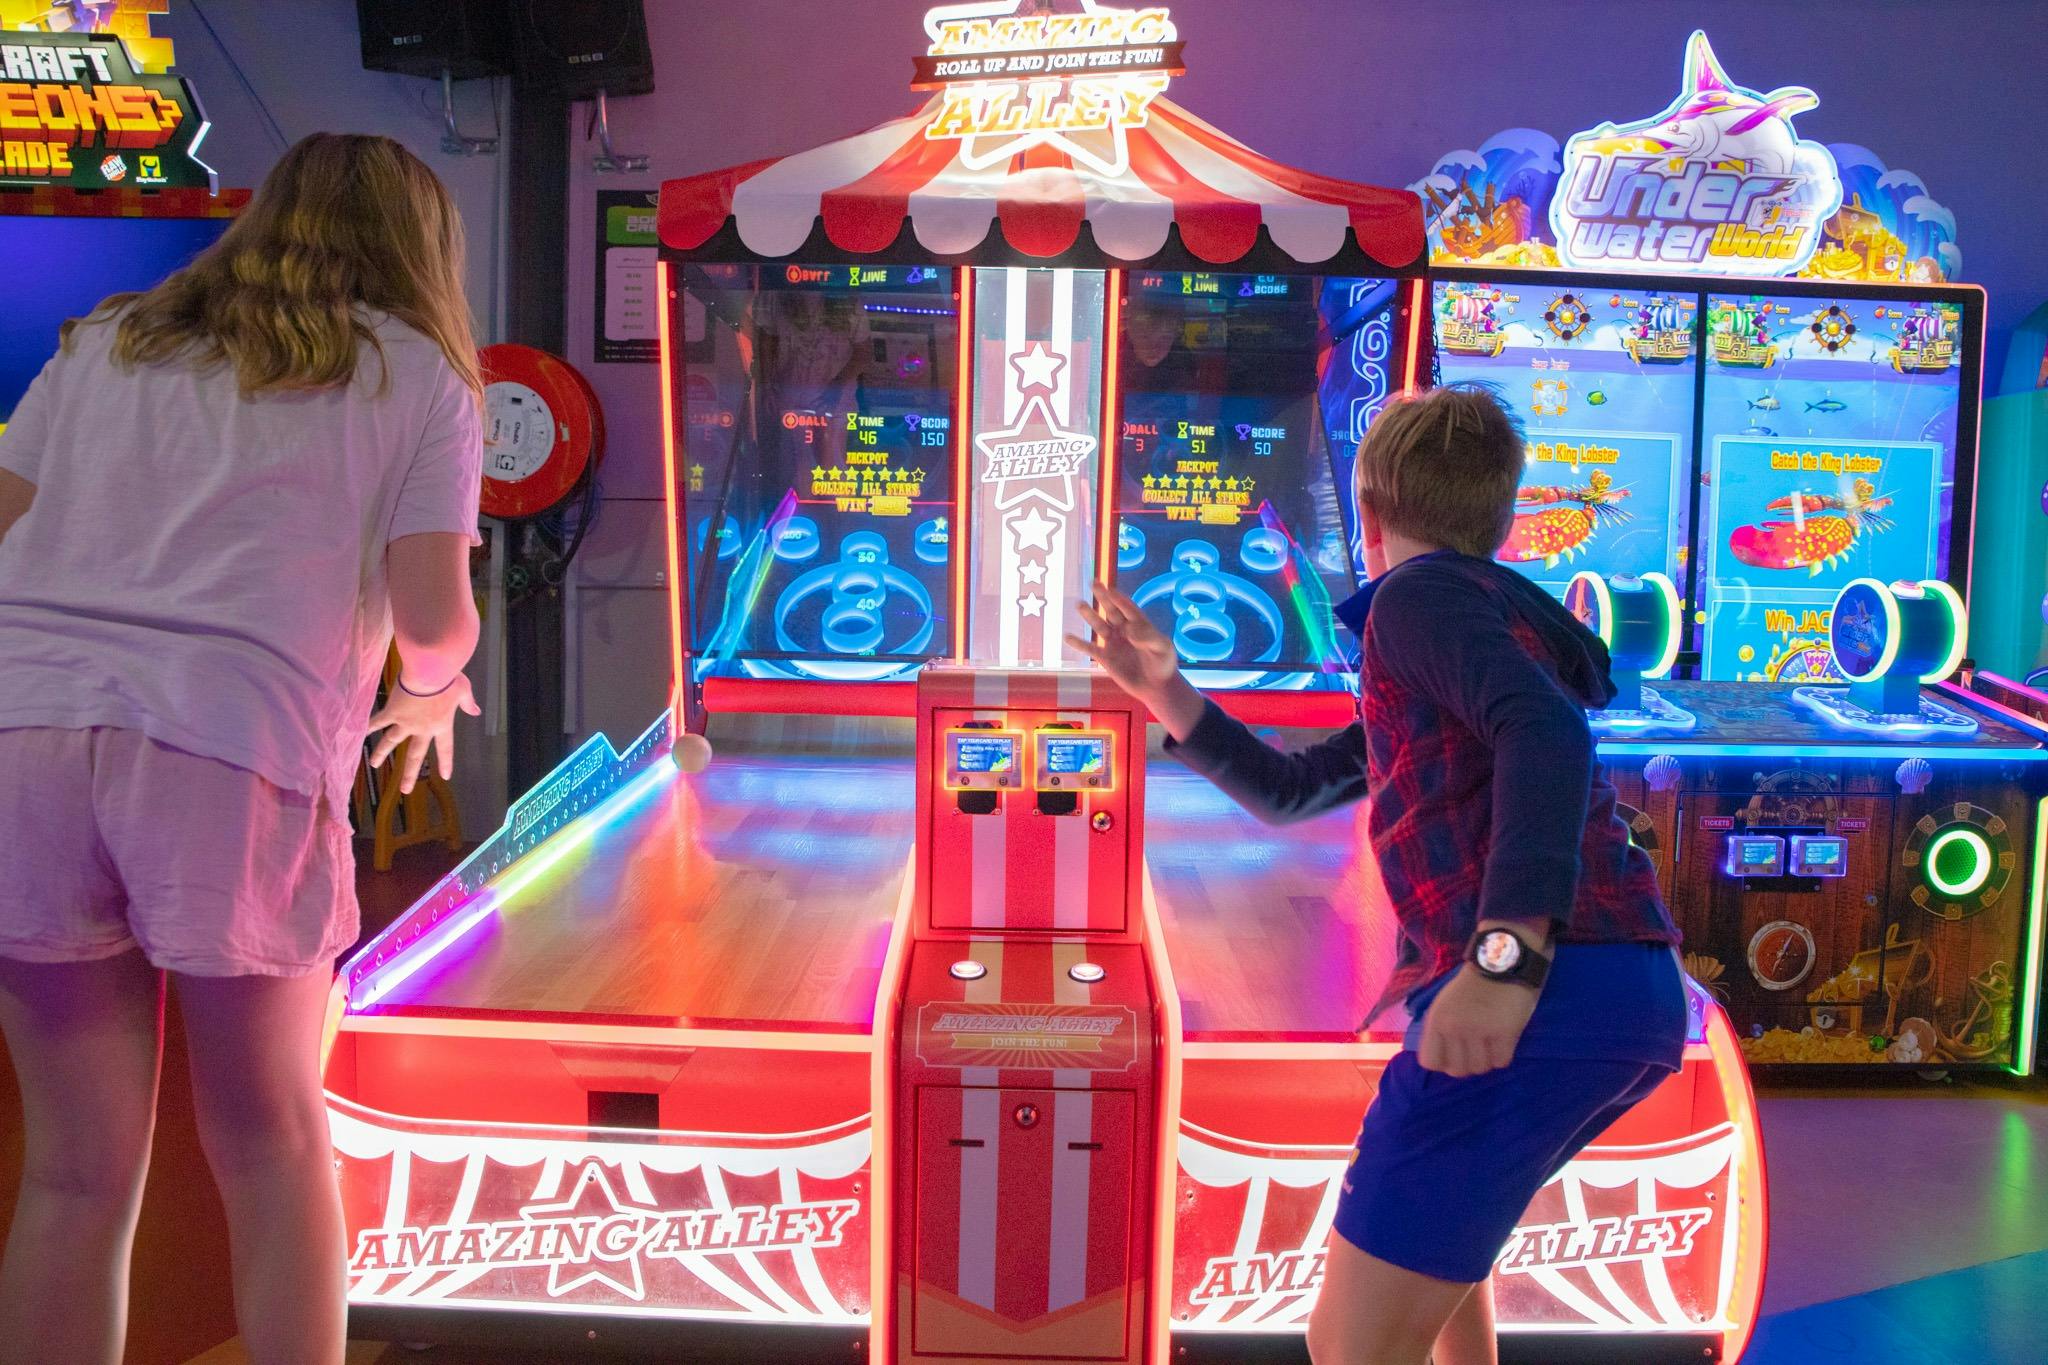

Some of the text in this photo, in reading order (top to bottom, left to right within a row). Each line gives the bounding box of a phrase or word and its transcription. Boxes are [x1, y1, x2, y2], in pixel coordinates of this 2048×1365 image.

[930, 13, 1166, 54] AMAZING
[0, 45, 113, 82] RAFT
[935, 48, 1164, 76] ROLL UP AND JOIN THE FUN!
[0, 83, 163, 142] EONS
[929, 79, 1166, 136] ALLEY
[0, 142, 74, 172] ADE
[1567, 156, 1798, 223] Under
[1710, 222, 1806, 259] World
[798, 416, 949, 429] BALL TIME SCOR
[1130, 424, 1286, 439] BALL TIME SCORE
[805, 430, 945, 446] 3 46 150
[1136, 438, 1272, 456] 3 51 50
[846, 452, 888, 465] JACKPOT
[993, 440, 1083, 459] AMAZING
[1536, 442, 1554, 461] the
[1555, 443, 1579, 467] King
[1580, 442, 1619, 464] Lobster
[985, 453, 1085, 479] ALLEY
[1176, 461, 1218, 473] JACKPOT
[1771, 451, 1882, 475] Catch the King Lobster
[811, 481, 920, 497] COLLECT ALL STARS
[1142, 489, 1250, 505] COLLECT ALL STARS
[836, 498, 867, 512] WIN
[1166, 506, 1197, 520] WIN
[856, 598, 876, 610] 40
[1765, 609, 1832, 633] Win JAC
[1704, 819, 1730, 827] TICKETS
[1841, 820, 1867, 828] TICKETS
[931, 1014, 1123, 1035] AMAZING ALLEY
[991, 1037, 1017, 1048] JOIN
[1018, 1036, 1040, 1047] THE
[352, 1204, 857, 1271] AMAZING ALLEY
[1502, 1212, 1707, 1267] ALLEY
